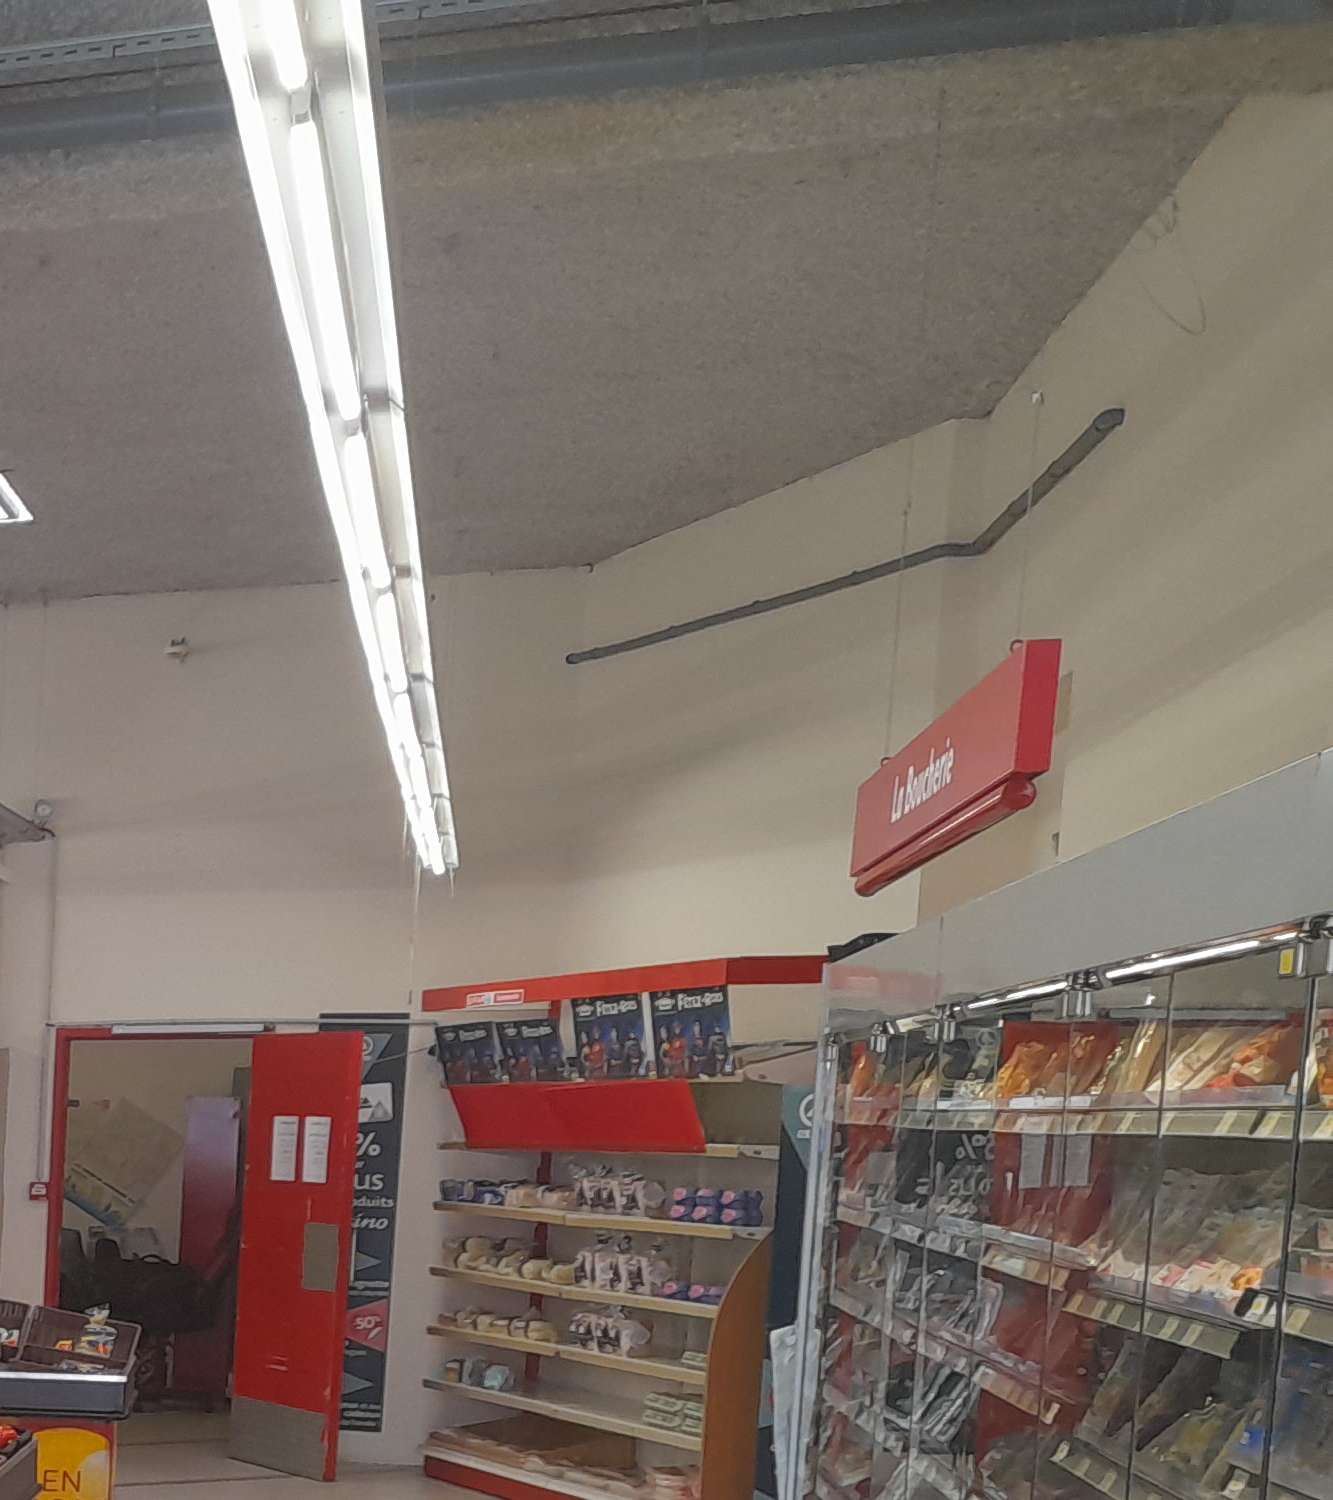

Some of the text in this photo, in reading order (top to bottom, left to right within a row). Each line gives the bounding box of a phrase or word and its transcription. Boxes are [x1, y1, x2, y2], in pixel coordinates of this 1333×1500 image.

[891, 736, 955, 824] La Boucherie
[42, 1469, 81, 1493] EN
